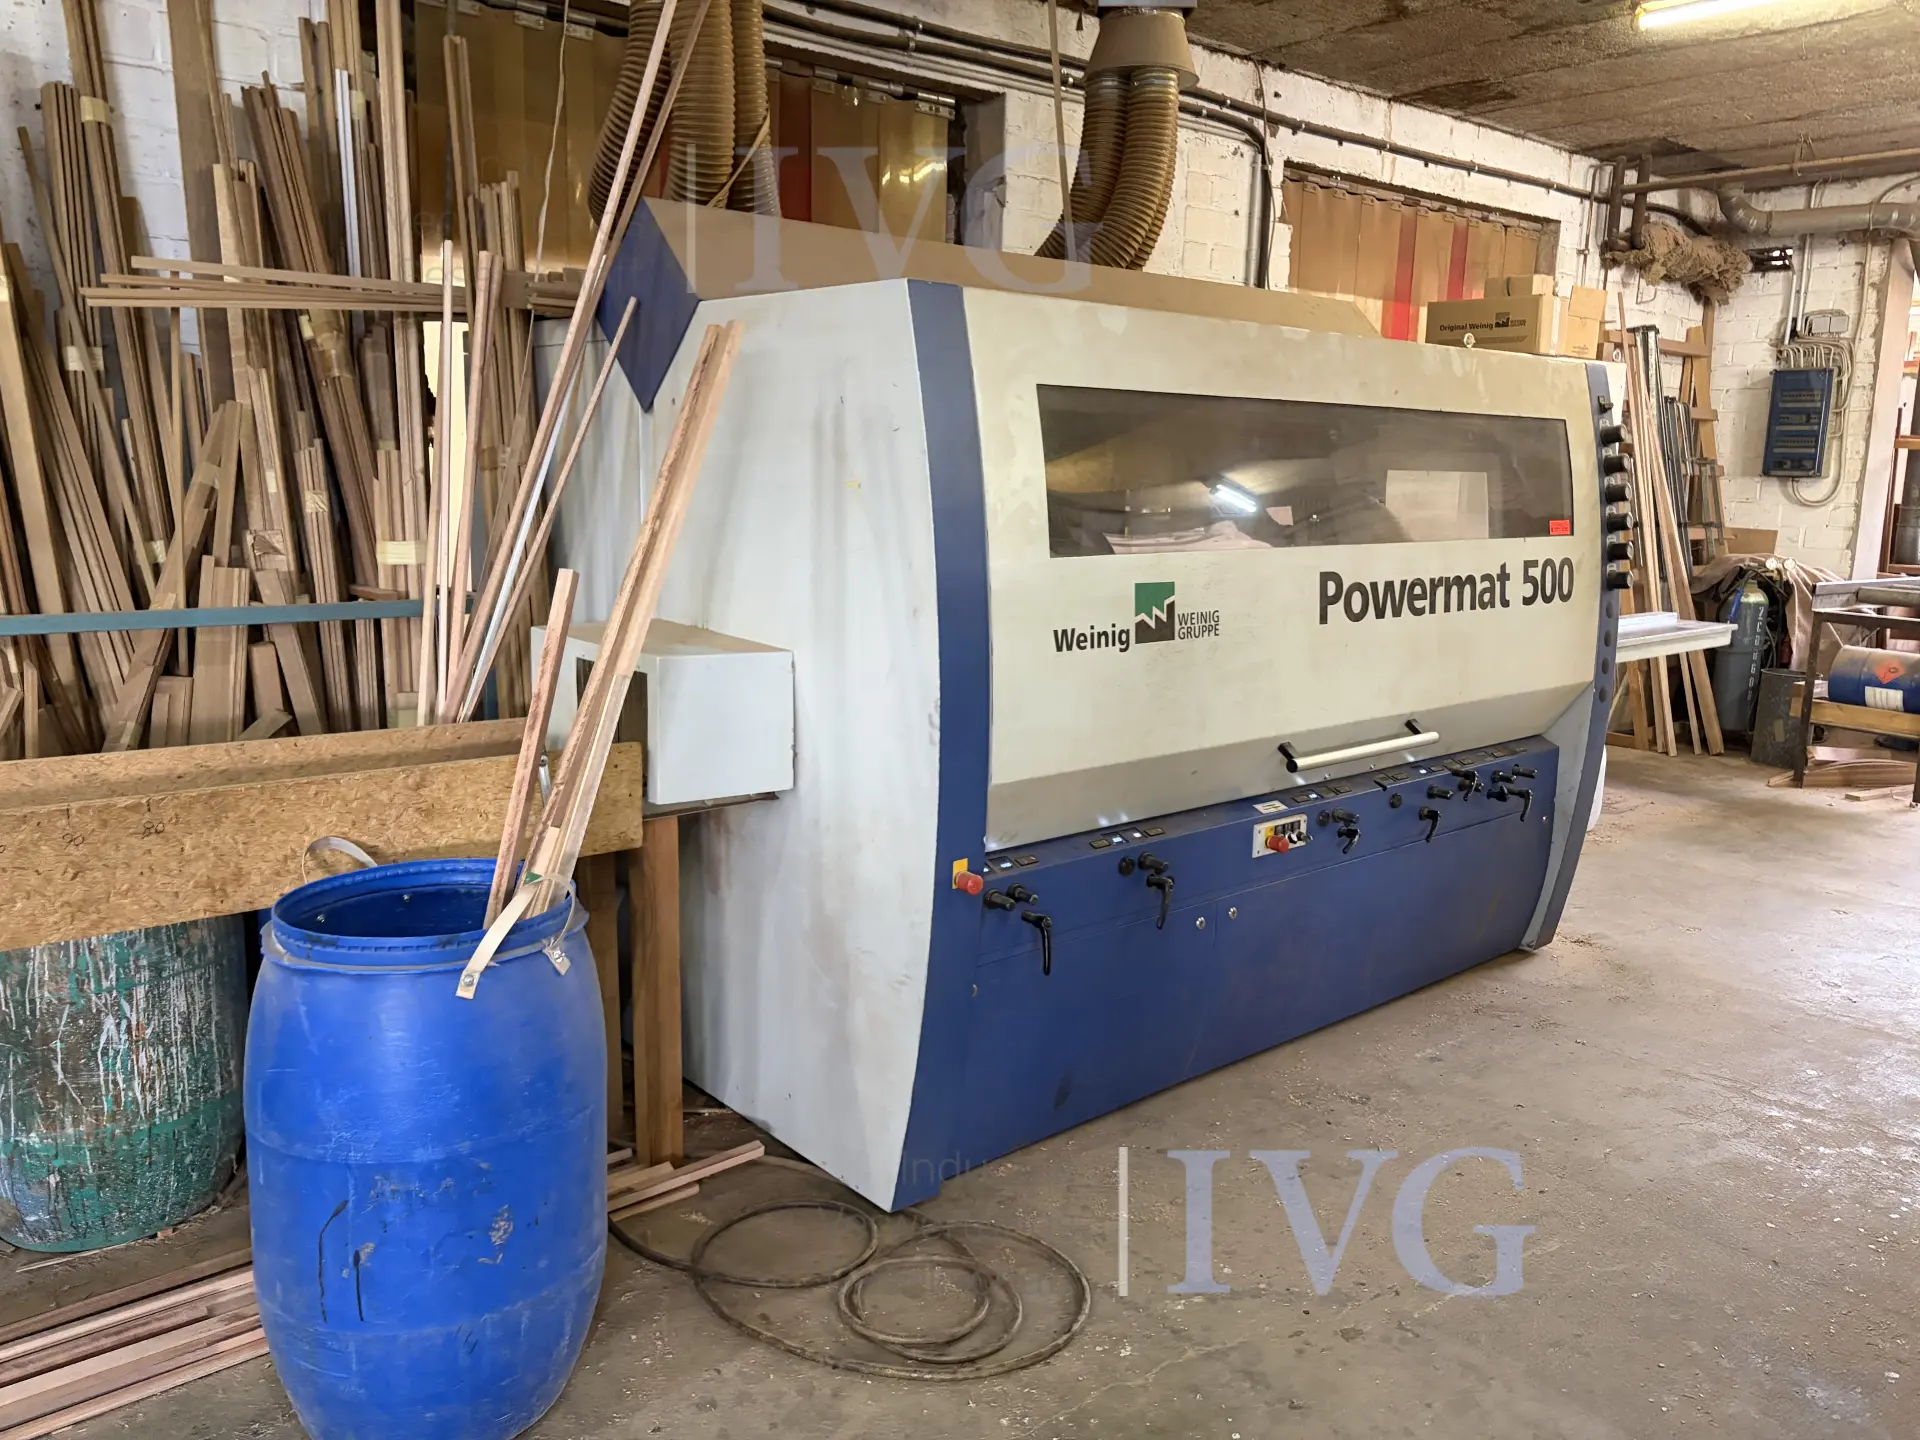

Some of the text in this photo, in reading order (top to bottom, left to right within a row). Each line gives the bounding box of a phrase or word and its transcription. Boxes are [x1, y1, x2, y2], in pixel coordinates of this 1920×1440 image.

[1439, 322, 1494, 332] Original Weinig
[1319, 556, 1575, 625] Powermat 500
[1177, 610, 1220, 626] WEINIG
[1052, 623, 1131, 653] Weinig
[1177, 624, 1220, 640] GRUPPE
